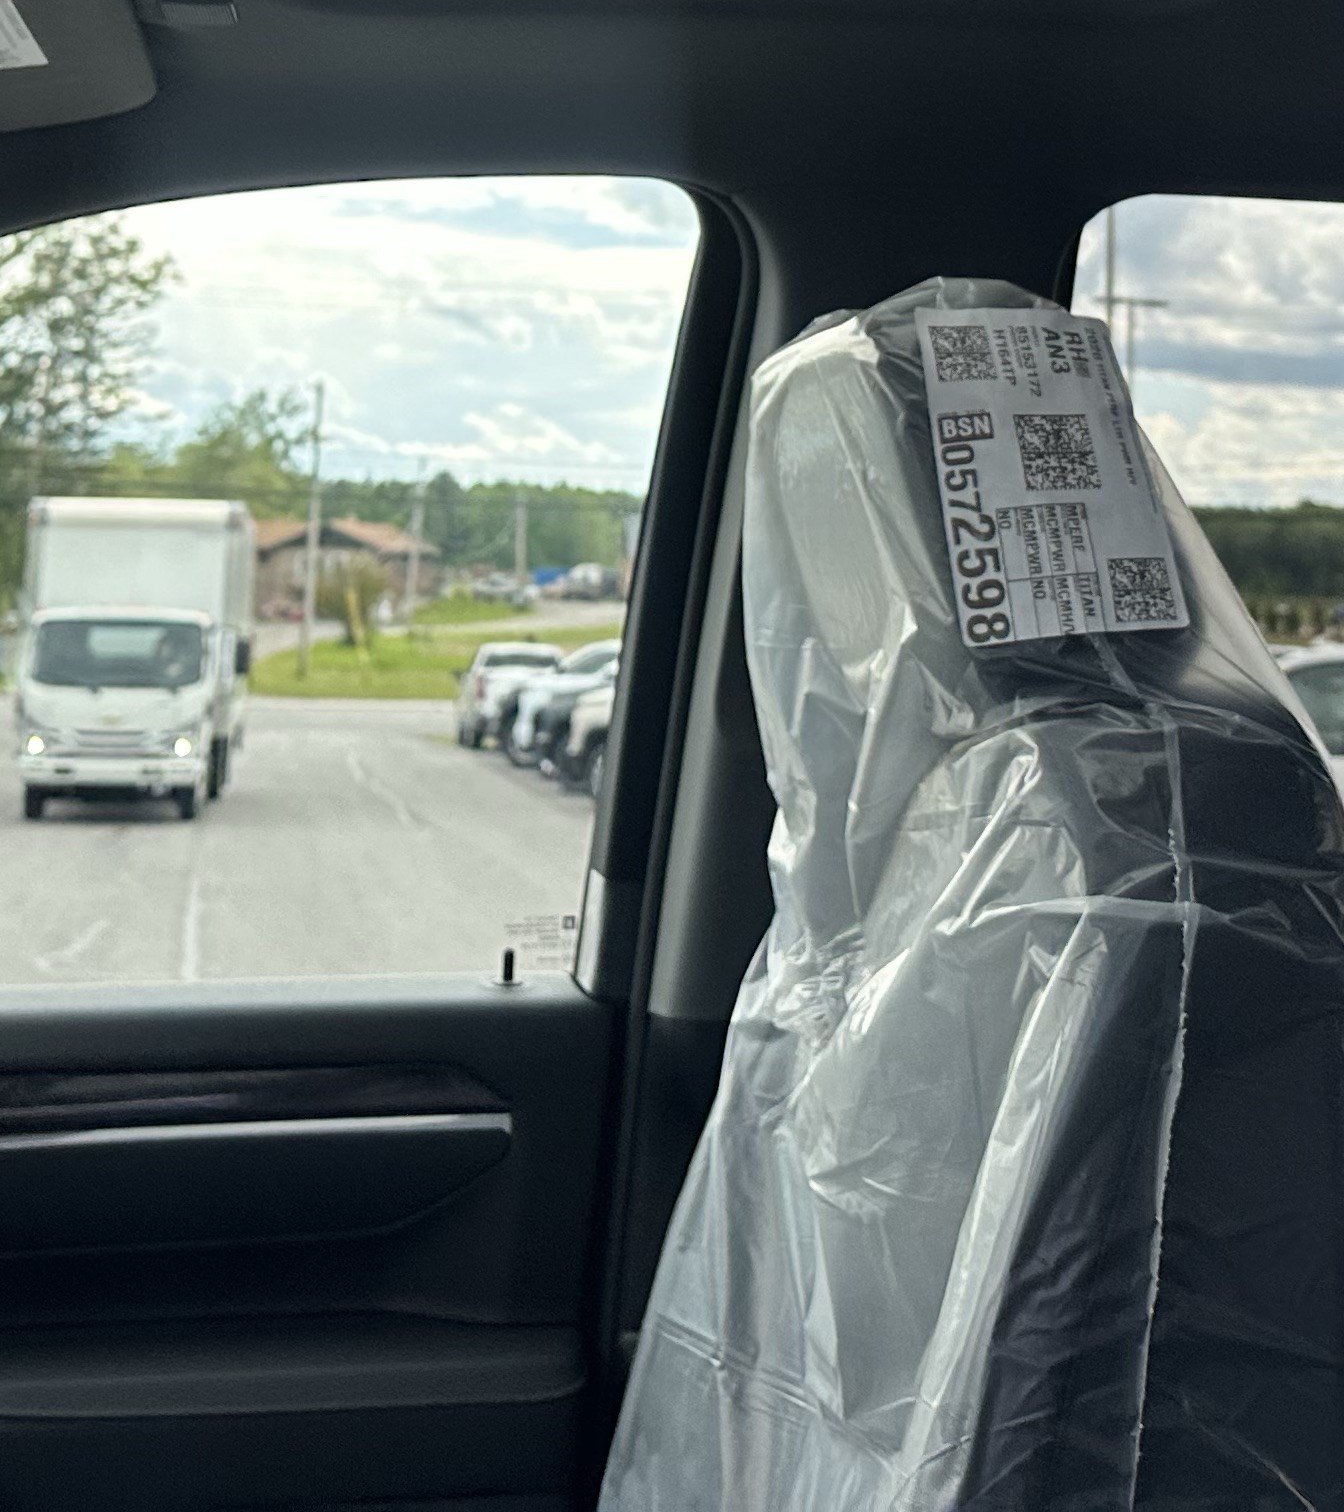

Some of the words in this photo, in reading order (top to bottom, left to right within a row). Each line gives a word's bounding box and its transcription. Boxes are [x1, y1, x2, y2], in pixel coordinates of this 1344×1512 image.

[1041, 327, 1071, 374] AN3
[1063, 331, 1088, 362] RH
[941, 414, 992, 441] BSN
[939, 443, 1013, 643] 0572598
